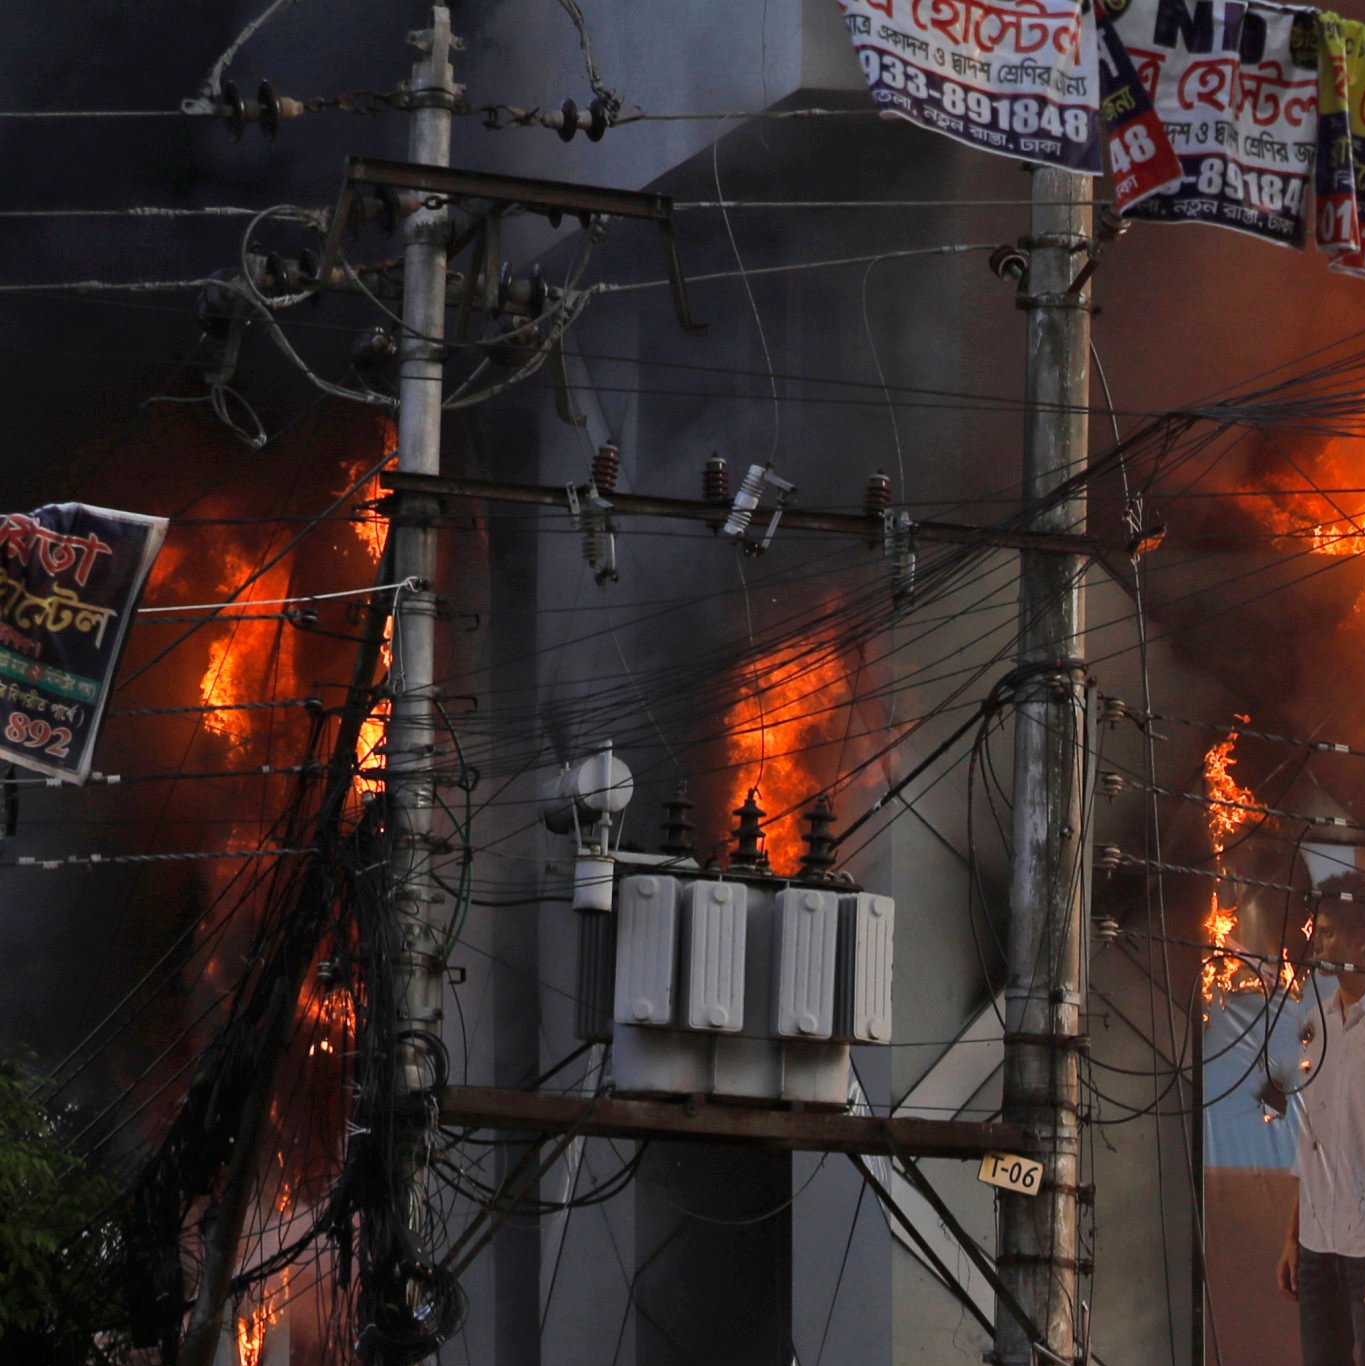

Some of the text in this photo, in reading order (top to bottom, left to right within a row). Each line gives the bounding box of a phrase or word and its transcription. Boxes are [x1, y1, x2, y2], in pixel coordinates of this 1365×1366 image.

[878, 25, 928, 60] একাদশ
[933, 48, 945, 67] ও
[912, 0, 1080, 65] হোস্টেল
[1196, 120, 1208, 143] ও
[5, 712, 72, 758] 892
[989, 1155, 1039, 1188] T-06
